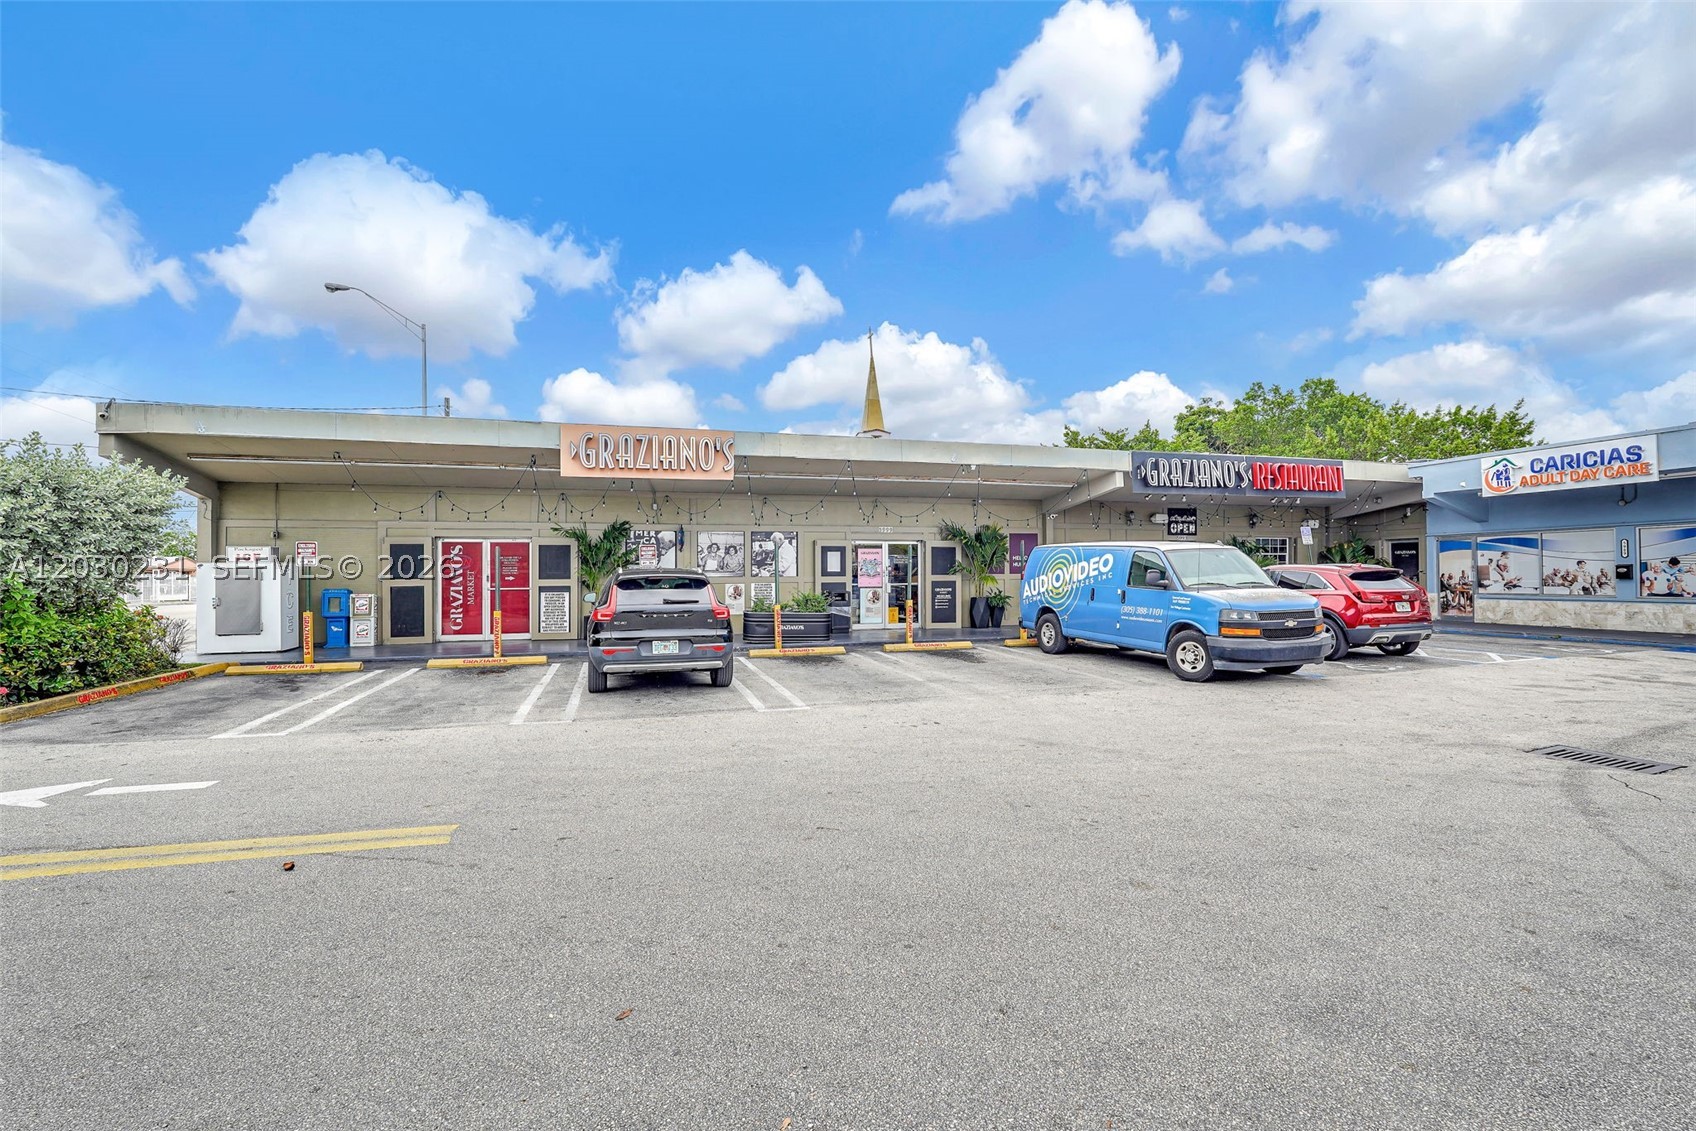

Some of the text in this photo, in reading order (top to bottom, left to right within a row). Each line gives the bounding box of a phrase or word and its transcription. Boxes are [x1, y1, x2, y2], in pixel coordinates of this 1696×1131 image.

[579, 432, 735, 471] GRAZIANO'S
[1530, 445, 1644, 475] CARICIAS
[1146, 457, 1344, 492] GRAZIANO'S RESTAURANT
[1519, 462, 1652, 488] ADULT DAY CARE
[1170, 522, 1195, 534] OPEN
[449, 545, 464, 631] GRAZIANO'S
[467, 570, 475, 605] MARKET
[1022, 553, 1114, 599] AUDIOVIDEO
[1098, 573, 1113, 581] INC
[303, 615, 311, 656] GRAZIANO'S
